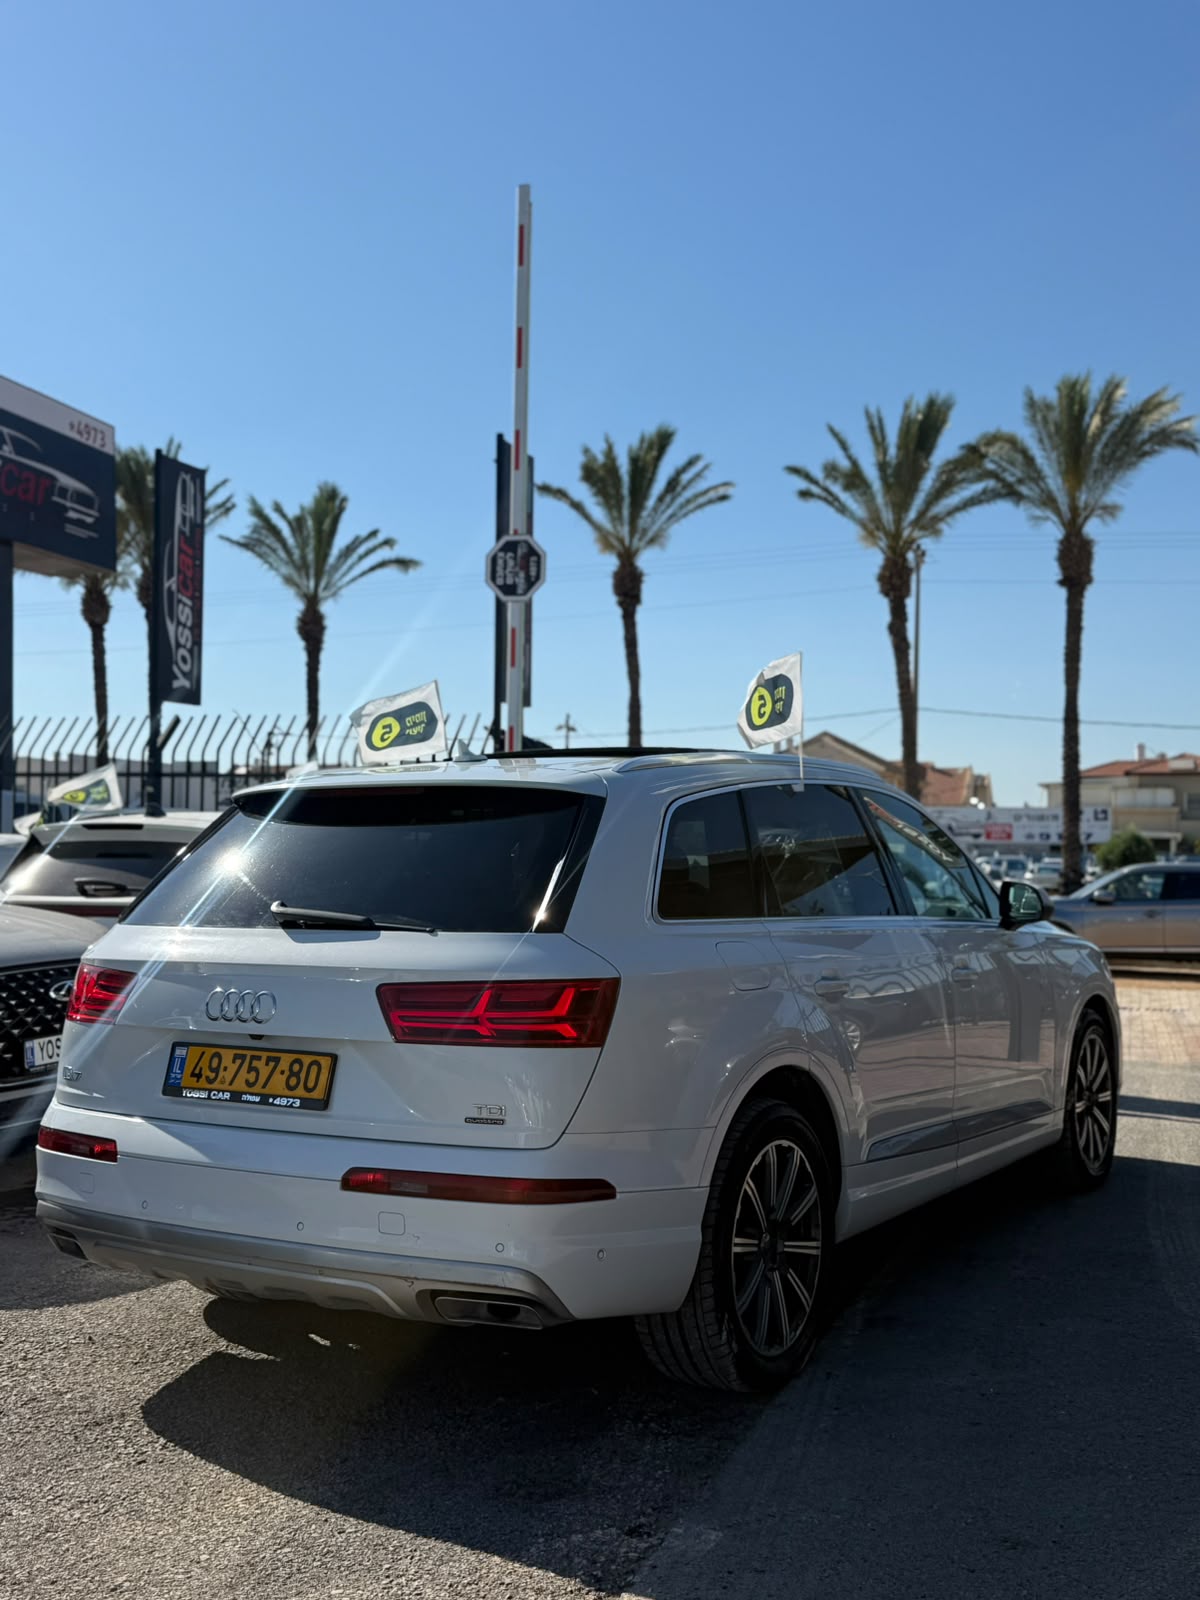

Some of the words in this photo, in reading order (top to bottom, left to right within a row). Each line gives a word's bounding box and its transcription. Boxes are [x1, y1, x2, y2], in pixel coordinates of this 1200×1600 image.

[0, 462, 51, 507] car
[182, 1087, 209, 1099] YOSSI
[210, 1090, 231, 1101] CAR
